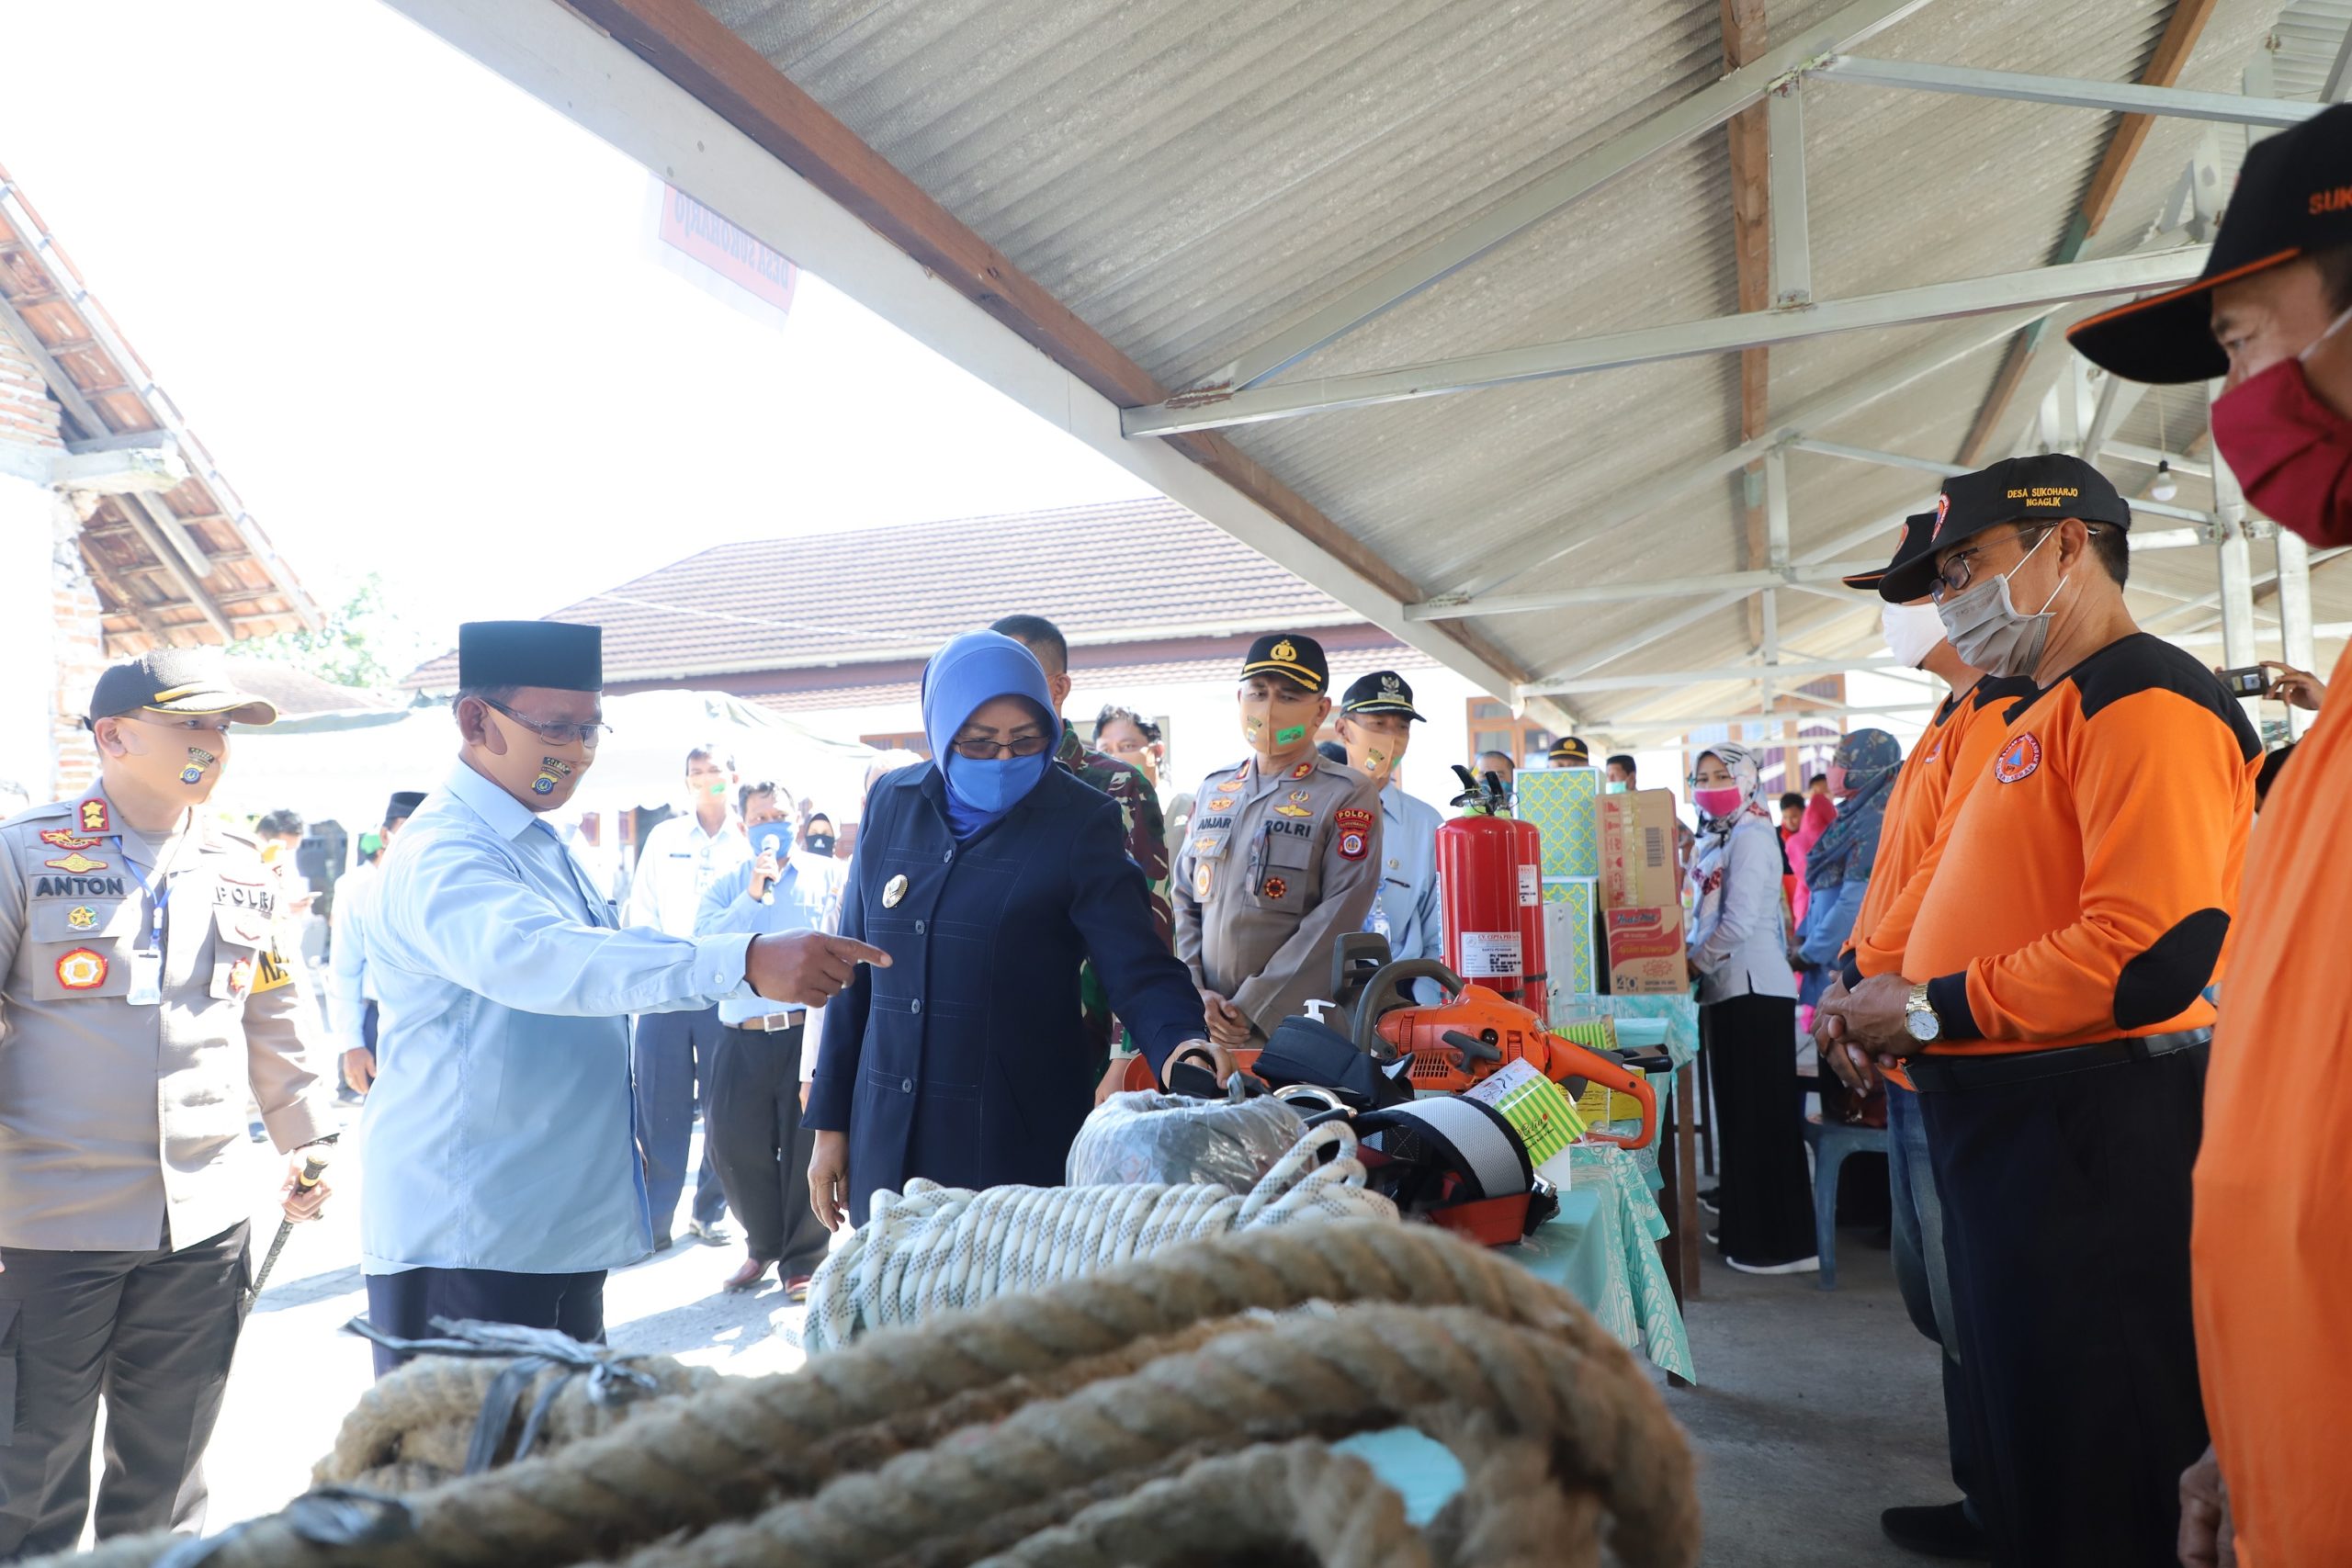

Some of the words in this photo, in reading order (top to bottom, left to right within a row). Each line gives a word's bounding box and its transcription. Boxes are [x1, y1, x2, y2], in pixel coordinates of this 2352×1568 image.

[2007, 489, 2029, 499] DESA
[2031, 487, 2078, 498] SUKOHARJO
[2026, 496, 2061, 507] NGAGLIK
[1338, 810, 1370, 820] POLDA
[1197, 817, 1232, 830] ANJAR
[1265, 819, 1311, 838] POLRI
[36, 876, 125, 897] ANTON
[215, 886, 275, 912] POLRI
